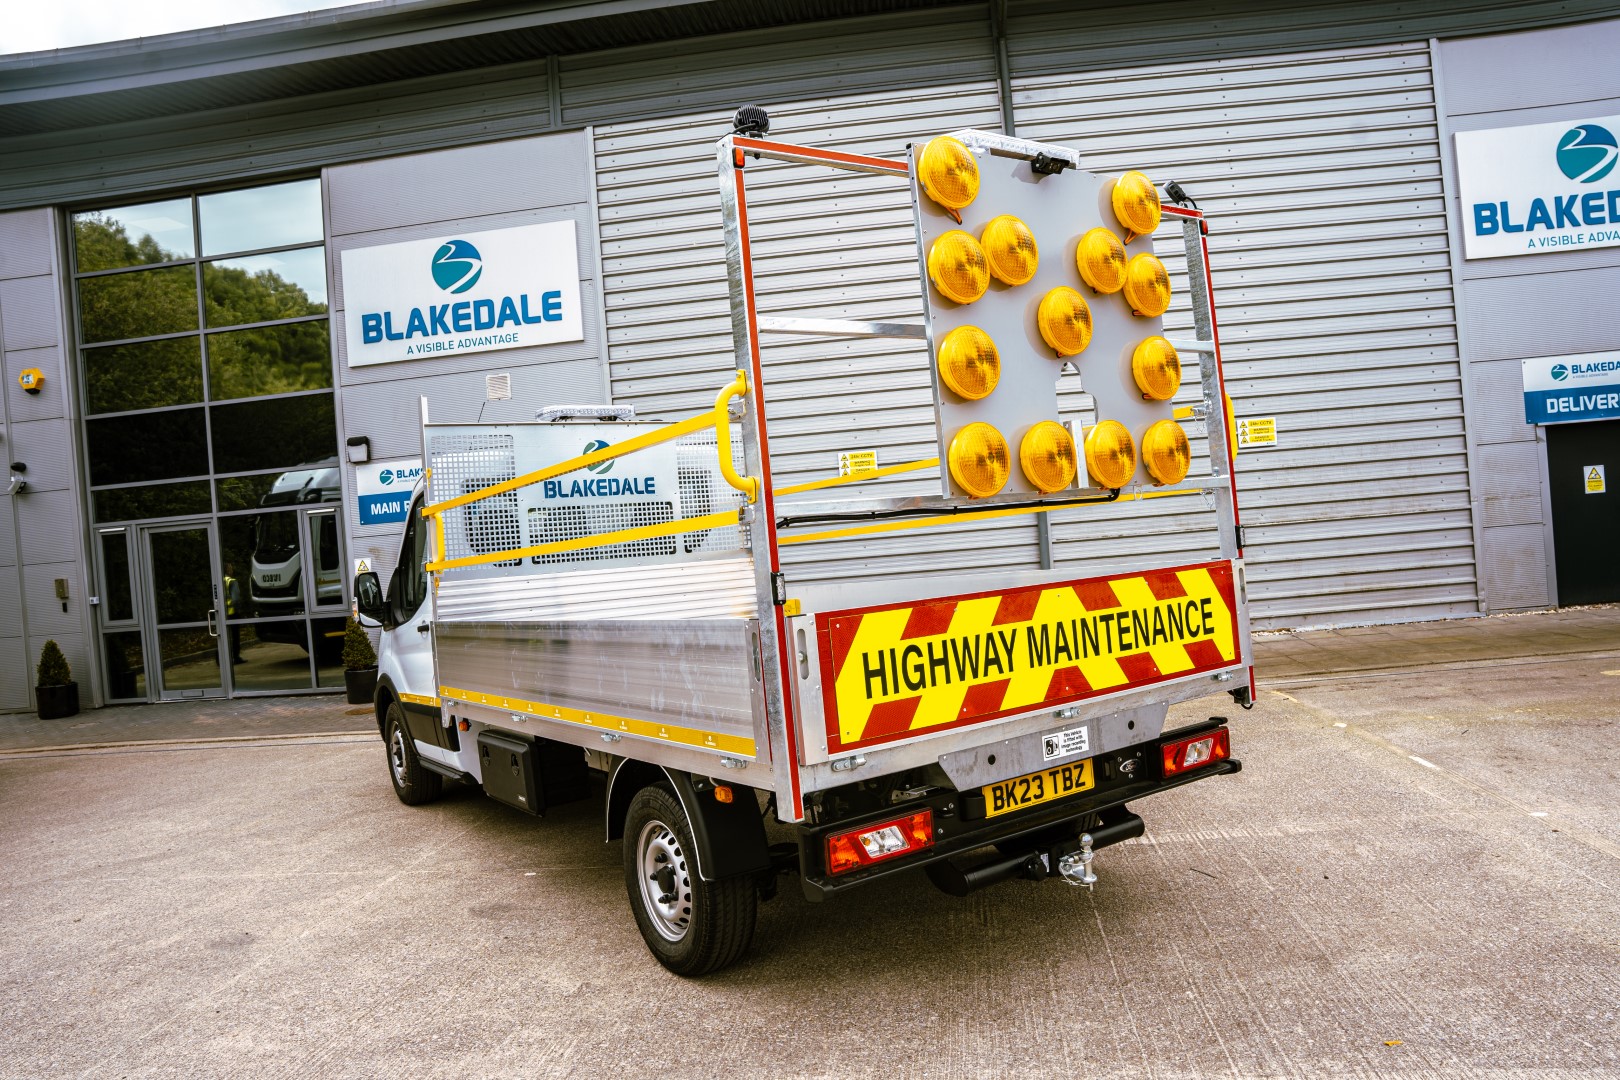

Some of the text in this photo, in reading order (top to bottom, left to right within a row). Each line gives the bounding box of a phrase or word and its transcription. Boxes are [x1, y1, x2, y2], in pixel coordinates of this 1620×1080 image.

[1528, 231, 1620, 248] A VISIBLE ADVA
[361, 290, 563, 344] BLAKEDALE
[407, 333, 519, 355] A VISIBLE ADVANTAGE
[1546, 392, 1620, 413] DELIVER
[396, 468, 423, 479] BLAK
[544, 477, 656, 499] BLAKEDALE
[371, 501, 401, 515] MAIN
[861, 597, 1215, 700] HIGHWAY MAINTENANCE
[992, 763, 1086, 811] BK23 TBZ
